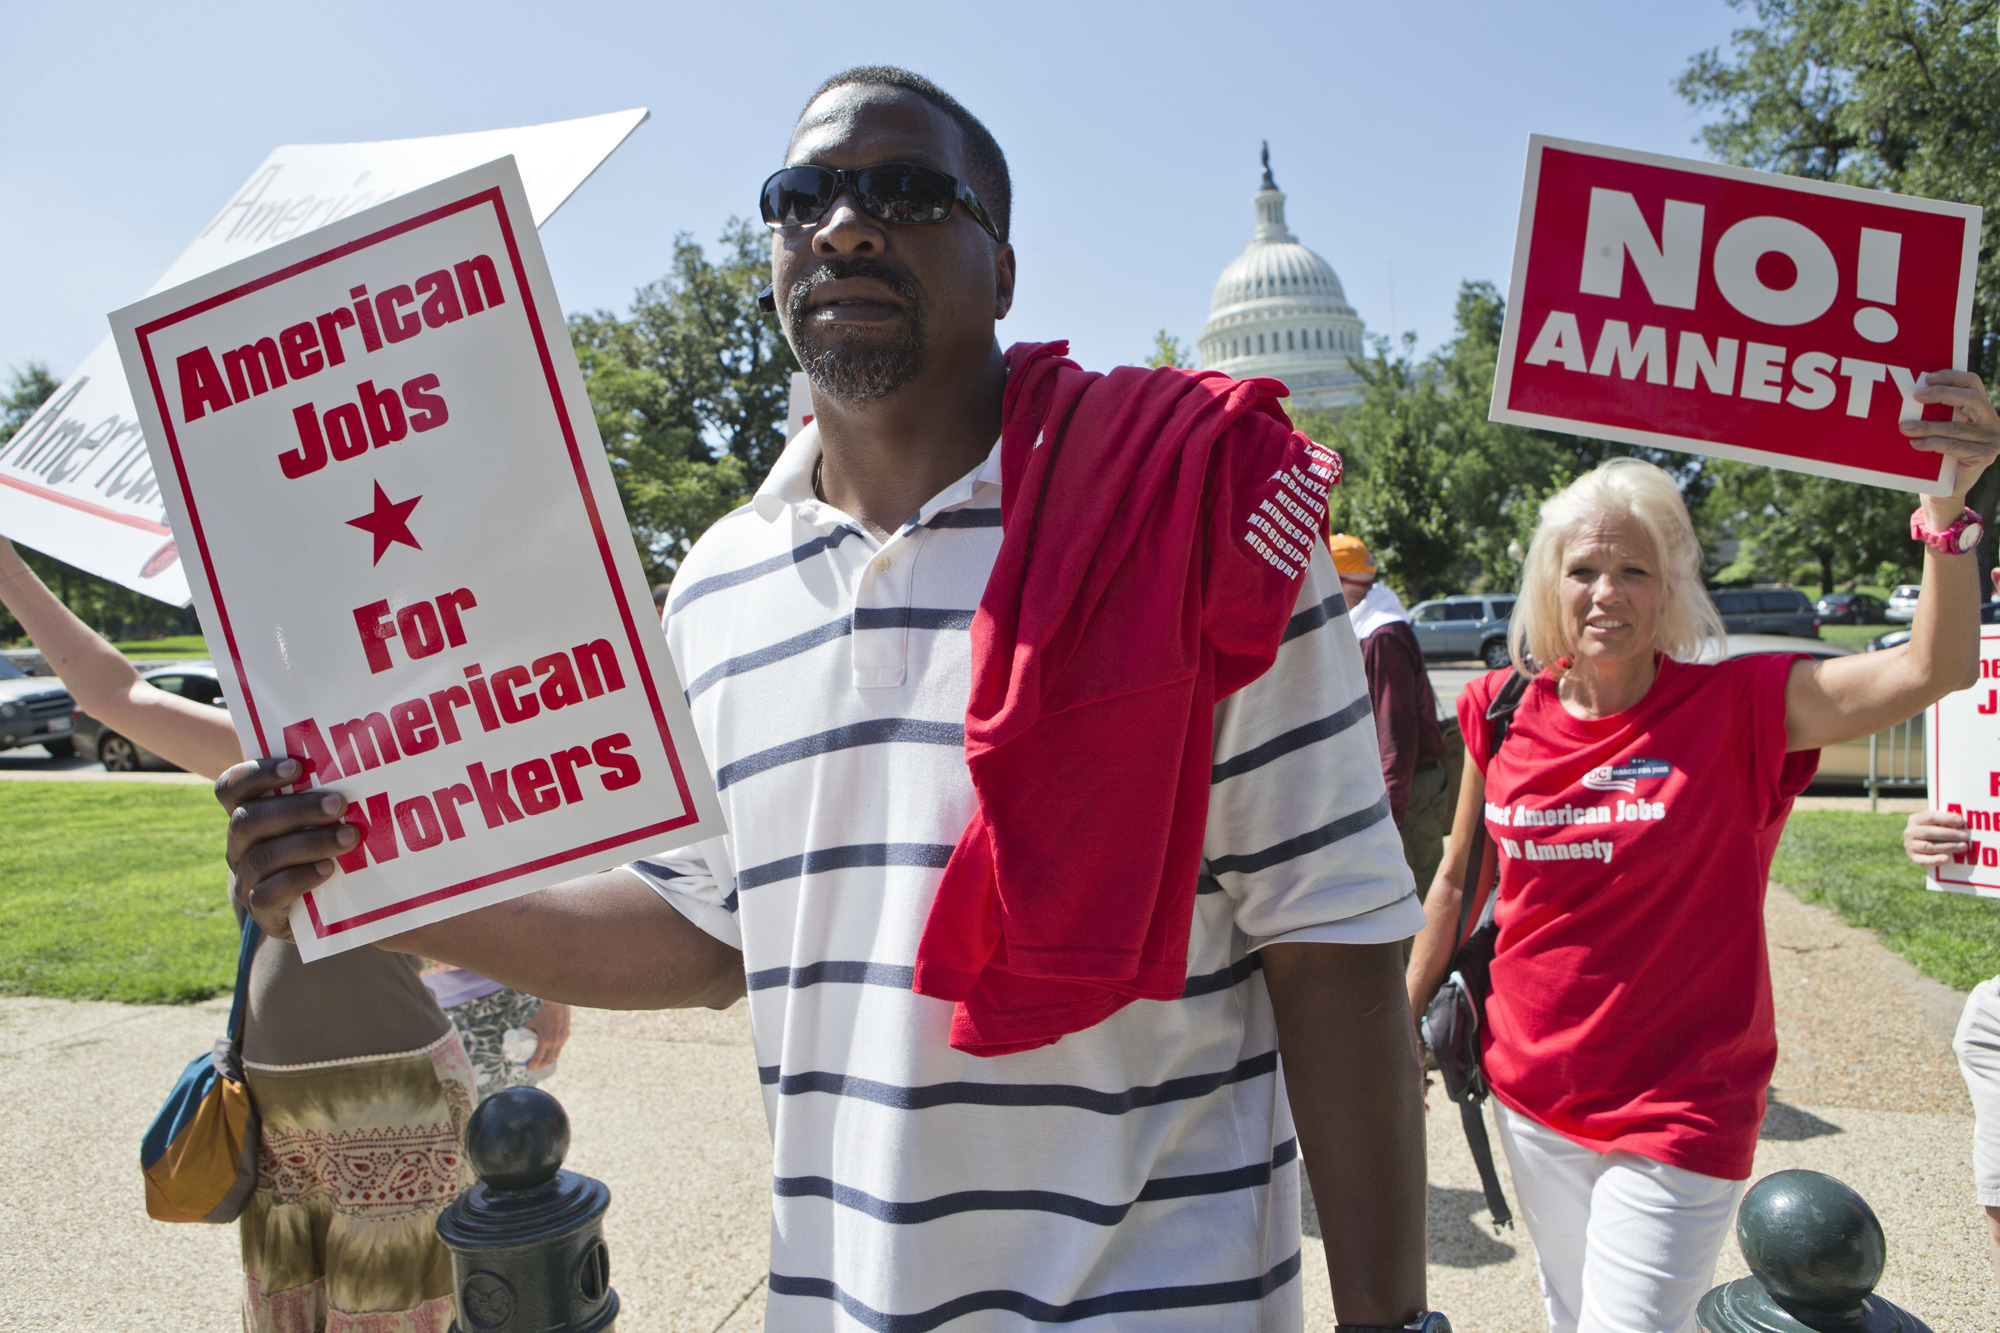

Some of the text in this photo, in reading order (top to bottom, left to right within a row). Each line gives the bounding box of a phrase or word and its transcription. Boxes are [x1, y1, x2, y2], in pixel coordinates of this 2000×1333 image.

[201, 163, 397, 242] Ameri
[1580, 187, 1902, 343] NO!
[177, 254, 506, 424] American
[1525, 310, 1929, 423] AMNESTY
[279, 374, 449, 480] Jobs
[1291, 464, 1329, 501] MARYL
[1244, 530, 1299, 580] MISSOURI
[1247, 512, 1309, 573] MISSISSIPP
[1259, 499, 1314, 555] MINNESOT
[353, 587, 478, 675] For
[283, 638, 626, 794] American
[323, 732, 642, 875] Workers
[1513, 803, 1611, 827] American
[1615, 798, 1666, 823] Jobs
[1588, 769, 1607, 780] DC
[1525, 838, 1613, 865] Amnesty
